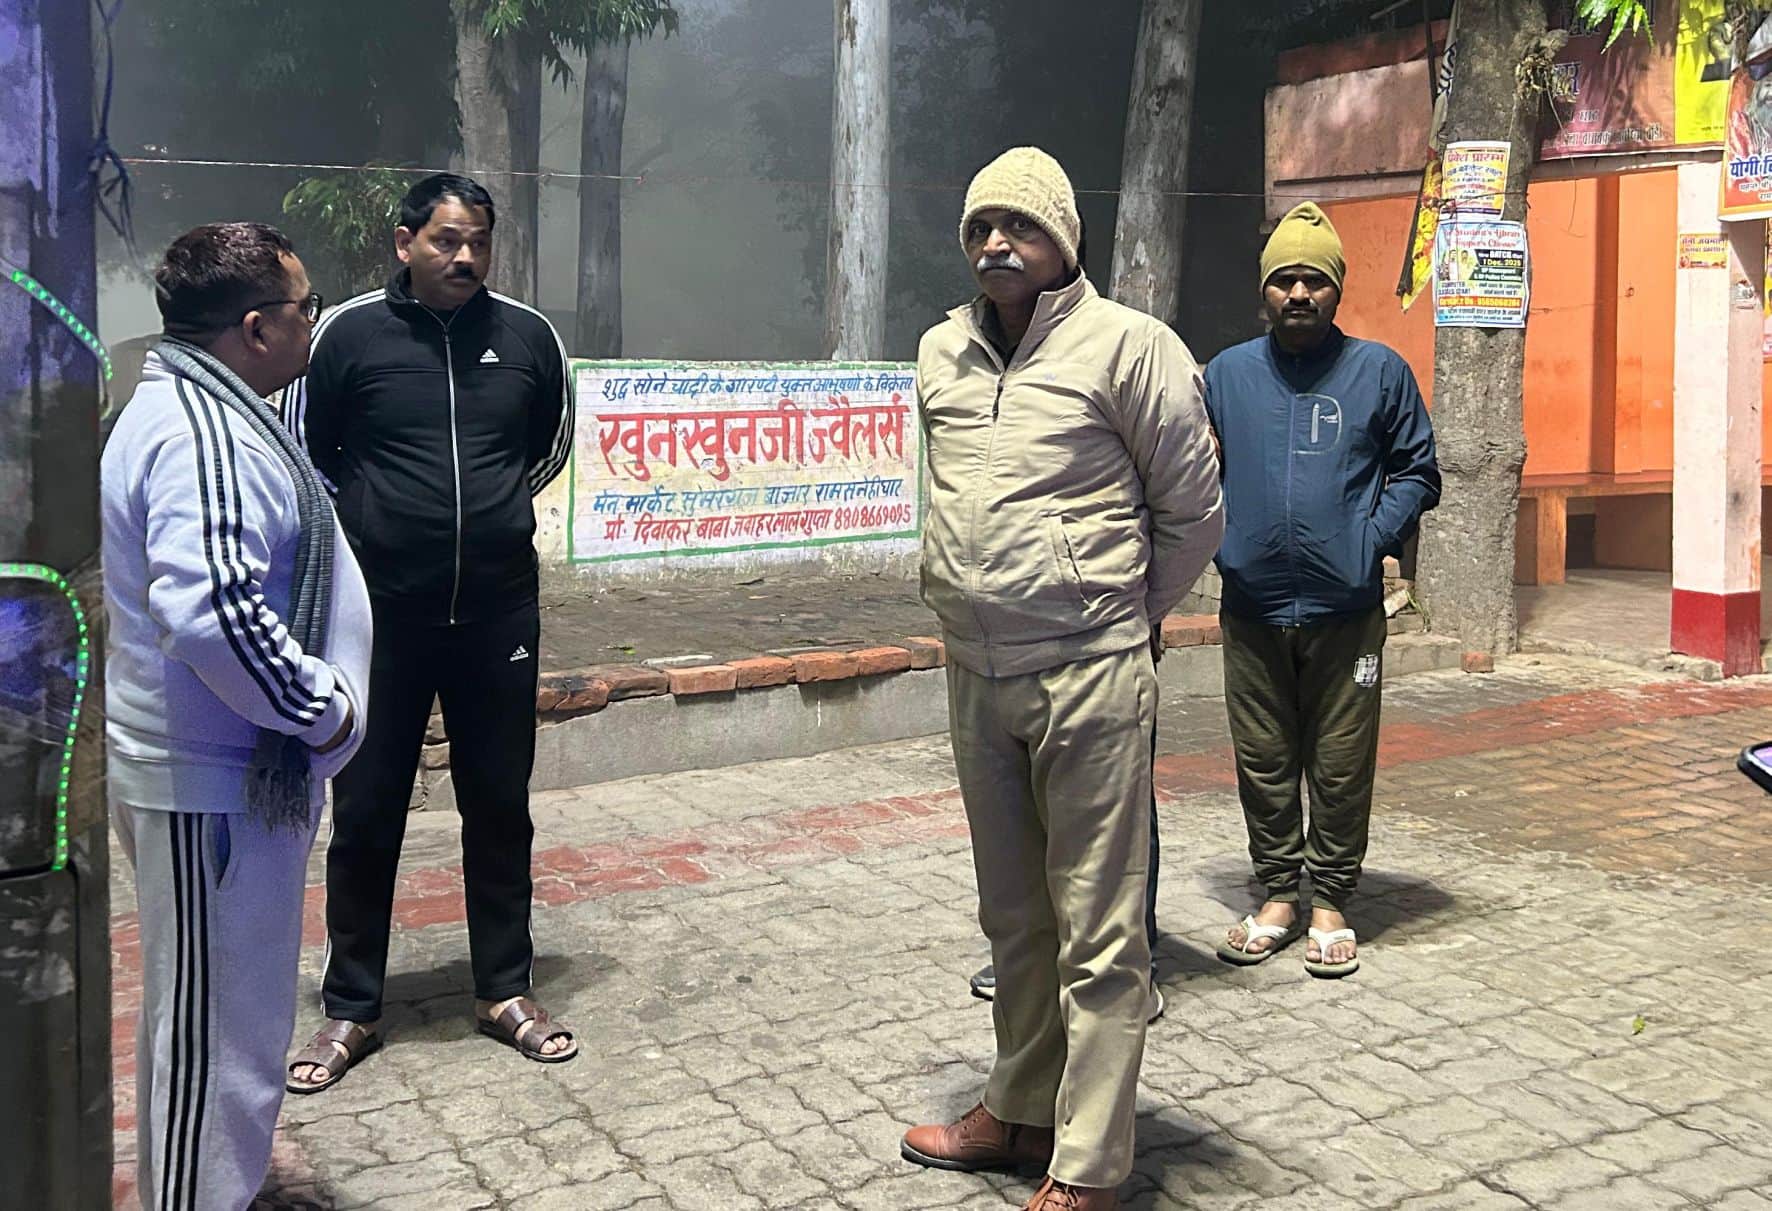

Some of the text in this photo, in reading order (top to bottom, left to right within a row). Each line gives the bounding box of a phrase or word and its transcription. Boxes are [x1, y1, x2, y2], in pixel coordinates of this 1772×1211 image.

[1730, 157, 1760, 177] योगी
[633, 372, 668, 396] सोने
[876, 373, 914, 394] विक्रेता
[624, 484, 677, 514] मार्केट
[633, 512, 696, 545] दिवाकर
